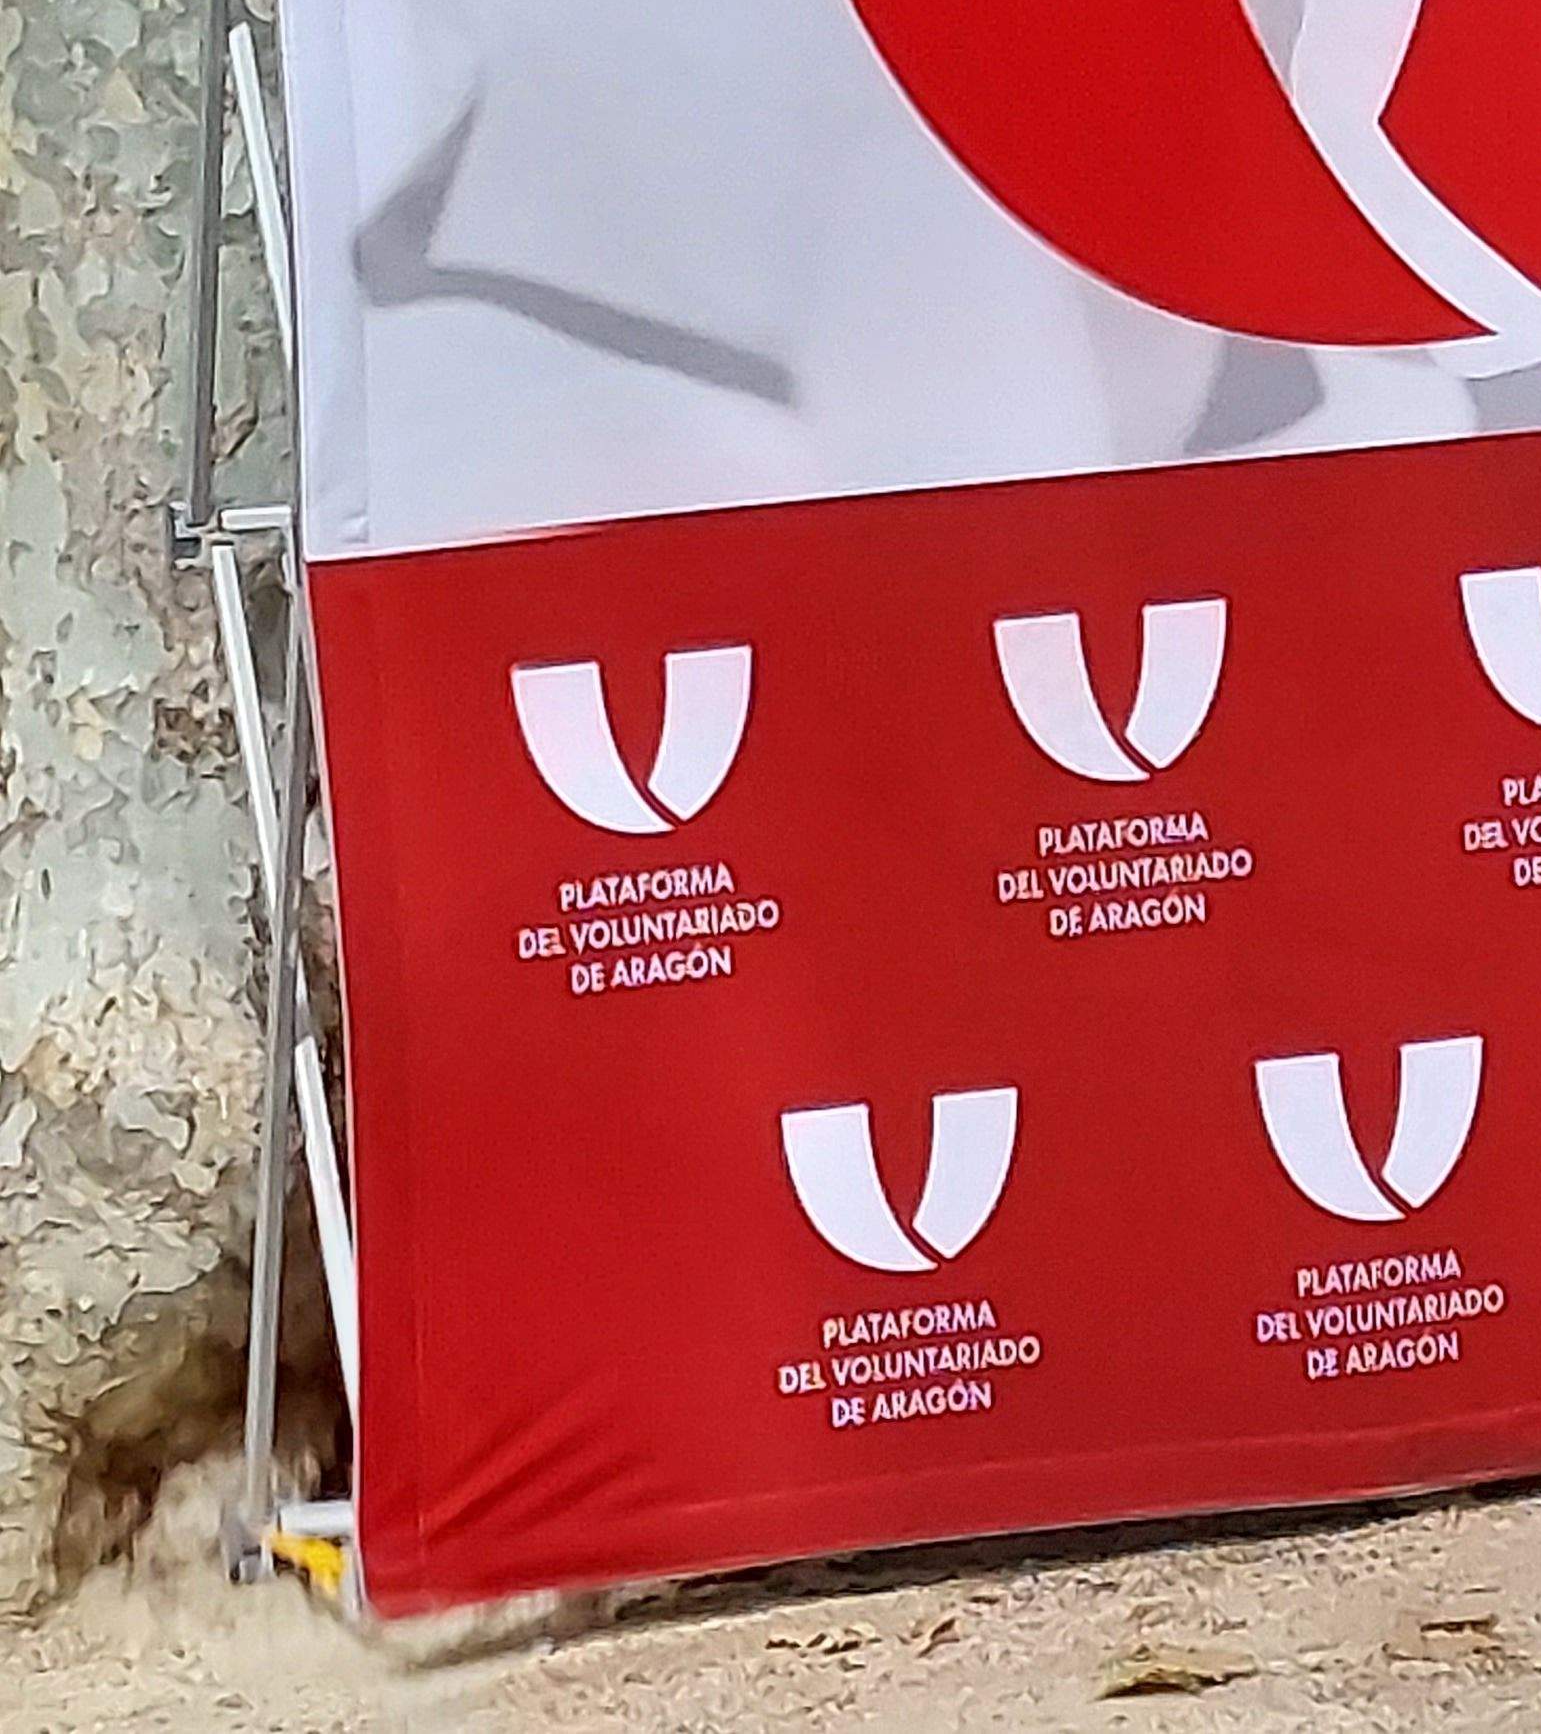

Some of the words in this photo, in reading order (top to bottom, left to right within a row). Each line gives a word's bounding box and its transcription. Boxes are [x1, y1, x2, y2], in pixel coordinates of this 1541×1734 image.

[1038, 811, 1210, 858] PLATAFORMA
[1463, 820, 1510, 852] DEL
[558, 861, 735, 913] PLATAFORMA
[997, 868, 1045, 904] DEL
[1046, 847, 1253, 896] VOLUNTARIADO
[518, 926, 567, 960] DEL
[568, 899, 780, 955] VOLUNTARIADO
[1049, 904, 1084, 938] DE
[1087, 892, 1207, 933] ARAGÓN
[570, 961, 606, 995] DE
[609, 941, 733, 988] ARAGÓN
[1296, 1248, 1462, 1298] PLATAFORMA
[822, 1299, 997, 1350] PLATAFORMA
[1256, 1311, 1302, 1343] DEL
[1304, 1283, 1505, 1338] VOLUNTARIADO
[777, 1361, 828, 1395] DEL
[830, 1335, 1041, 1387] VOLUNTARIADO
[1306, 1347, 1340, 1381] DE
[1345, 1330, 1460, 1375] ARAGÓN
[831, 1396, 867, 1429] DE
[871, 1377, 993, 1423] ARAGÓN
